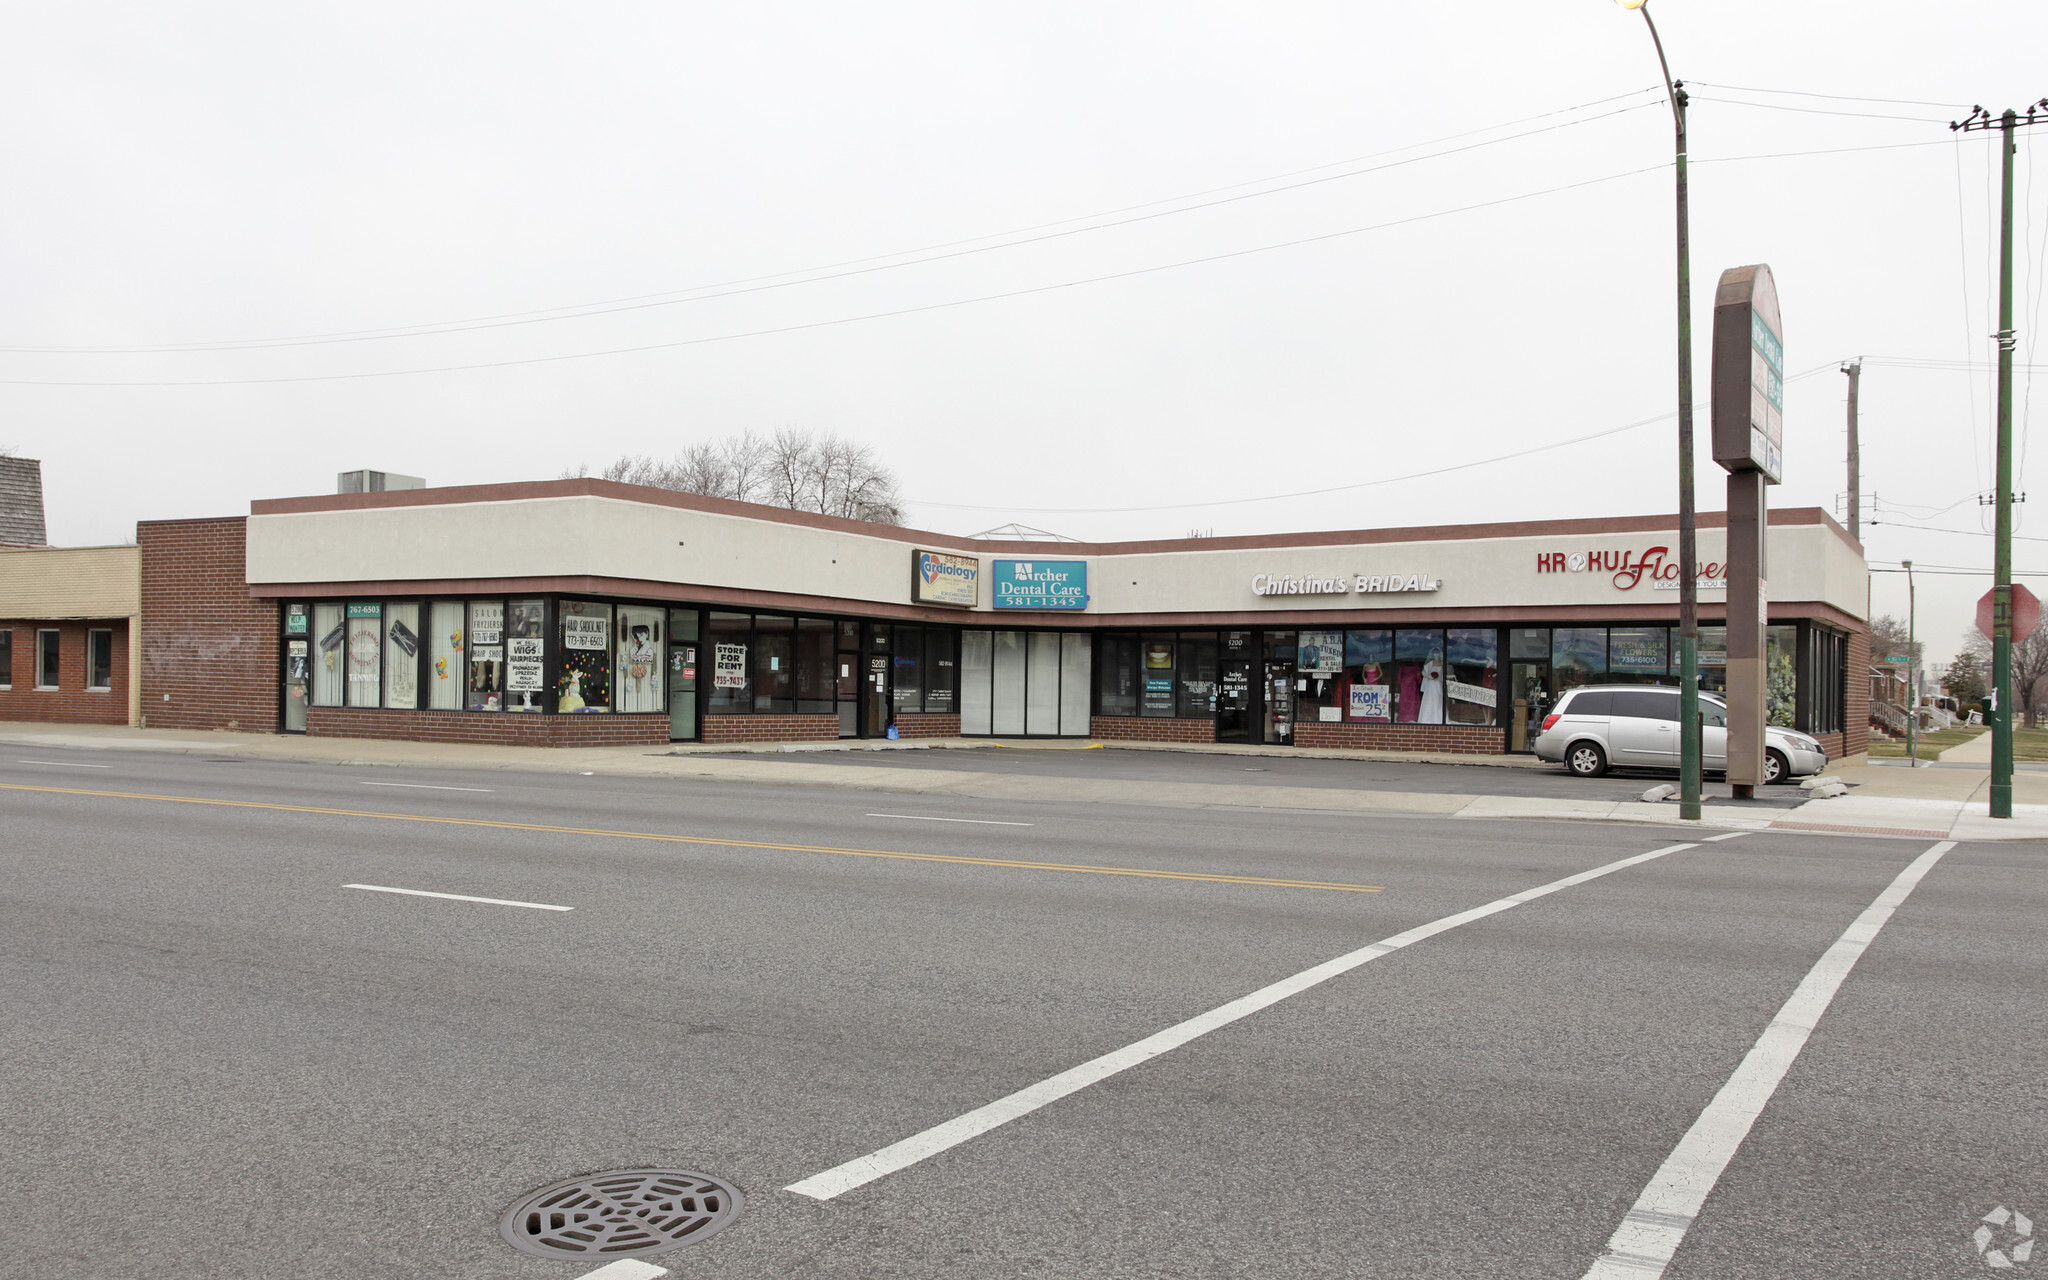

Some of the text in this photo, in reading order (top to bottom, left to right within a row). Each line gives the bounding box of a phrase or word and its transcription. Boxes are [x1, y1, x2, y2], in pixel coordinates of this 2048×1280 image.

[921, 554, 977, 580] Cardiology
[1014, 562, 1069, 581] Archer
[1000, 581, 1081, 596] Dental Care
[1251, 573, 1437, 596] Christina's BRIDAL
[1006, 597, 1076, 607] 581-1345
[350, 605, 380, 613] 767-6503
[566, 619, 579, 632] HAIR
[567, 635, 604, 646] 773-767-6503
[473, 649, 486, 658] HAIR
[514, 646, 537, 655] WIGS
[717, 646, 744, 654] STORE
[720, 654, 740, 662] FOR
[1621, 656, 1657, 664] 735-6100
[717, 662, 743, 670] RENT
[871, 659, 886, 668] 5200
[349, 673, 380, 682] TANNING
[1352, 691, 1379, 703] PROM
[1446, 682, 1497, 704] COMMUNION
[1365, 704, 1382, 716] 25
